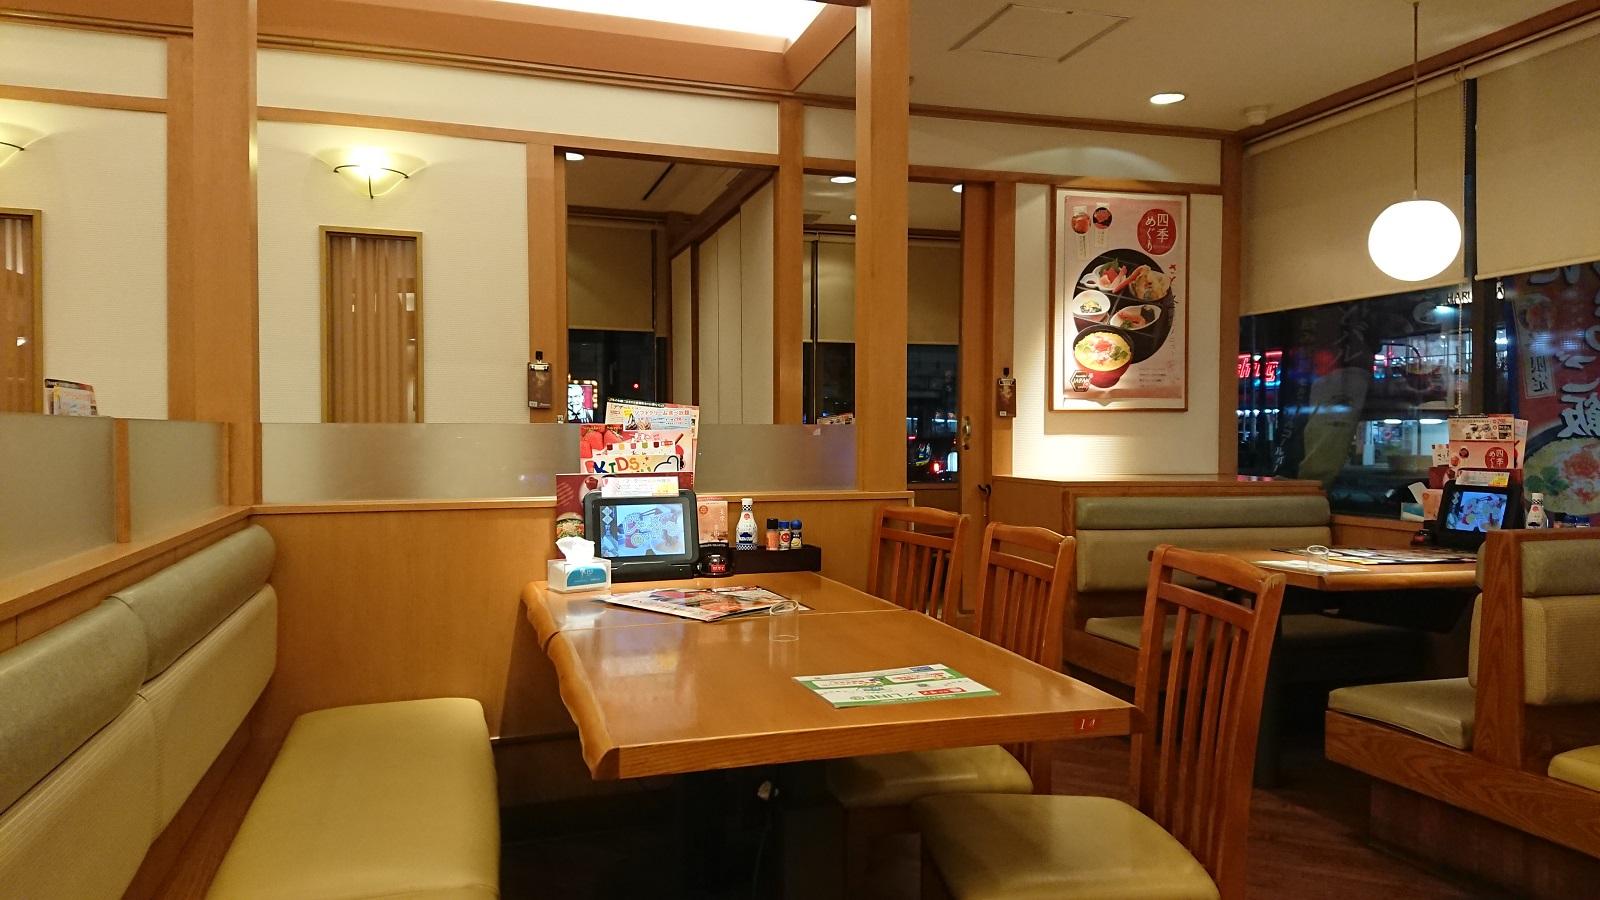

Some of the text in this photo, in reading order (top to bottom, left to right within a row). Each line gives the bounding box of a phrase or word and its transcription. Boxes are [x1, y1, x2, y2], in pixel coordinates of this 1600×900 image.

[1145, 216, 1156, 252] めぐり
[1157, 214, 1168, 243] 四季
